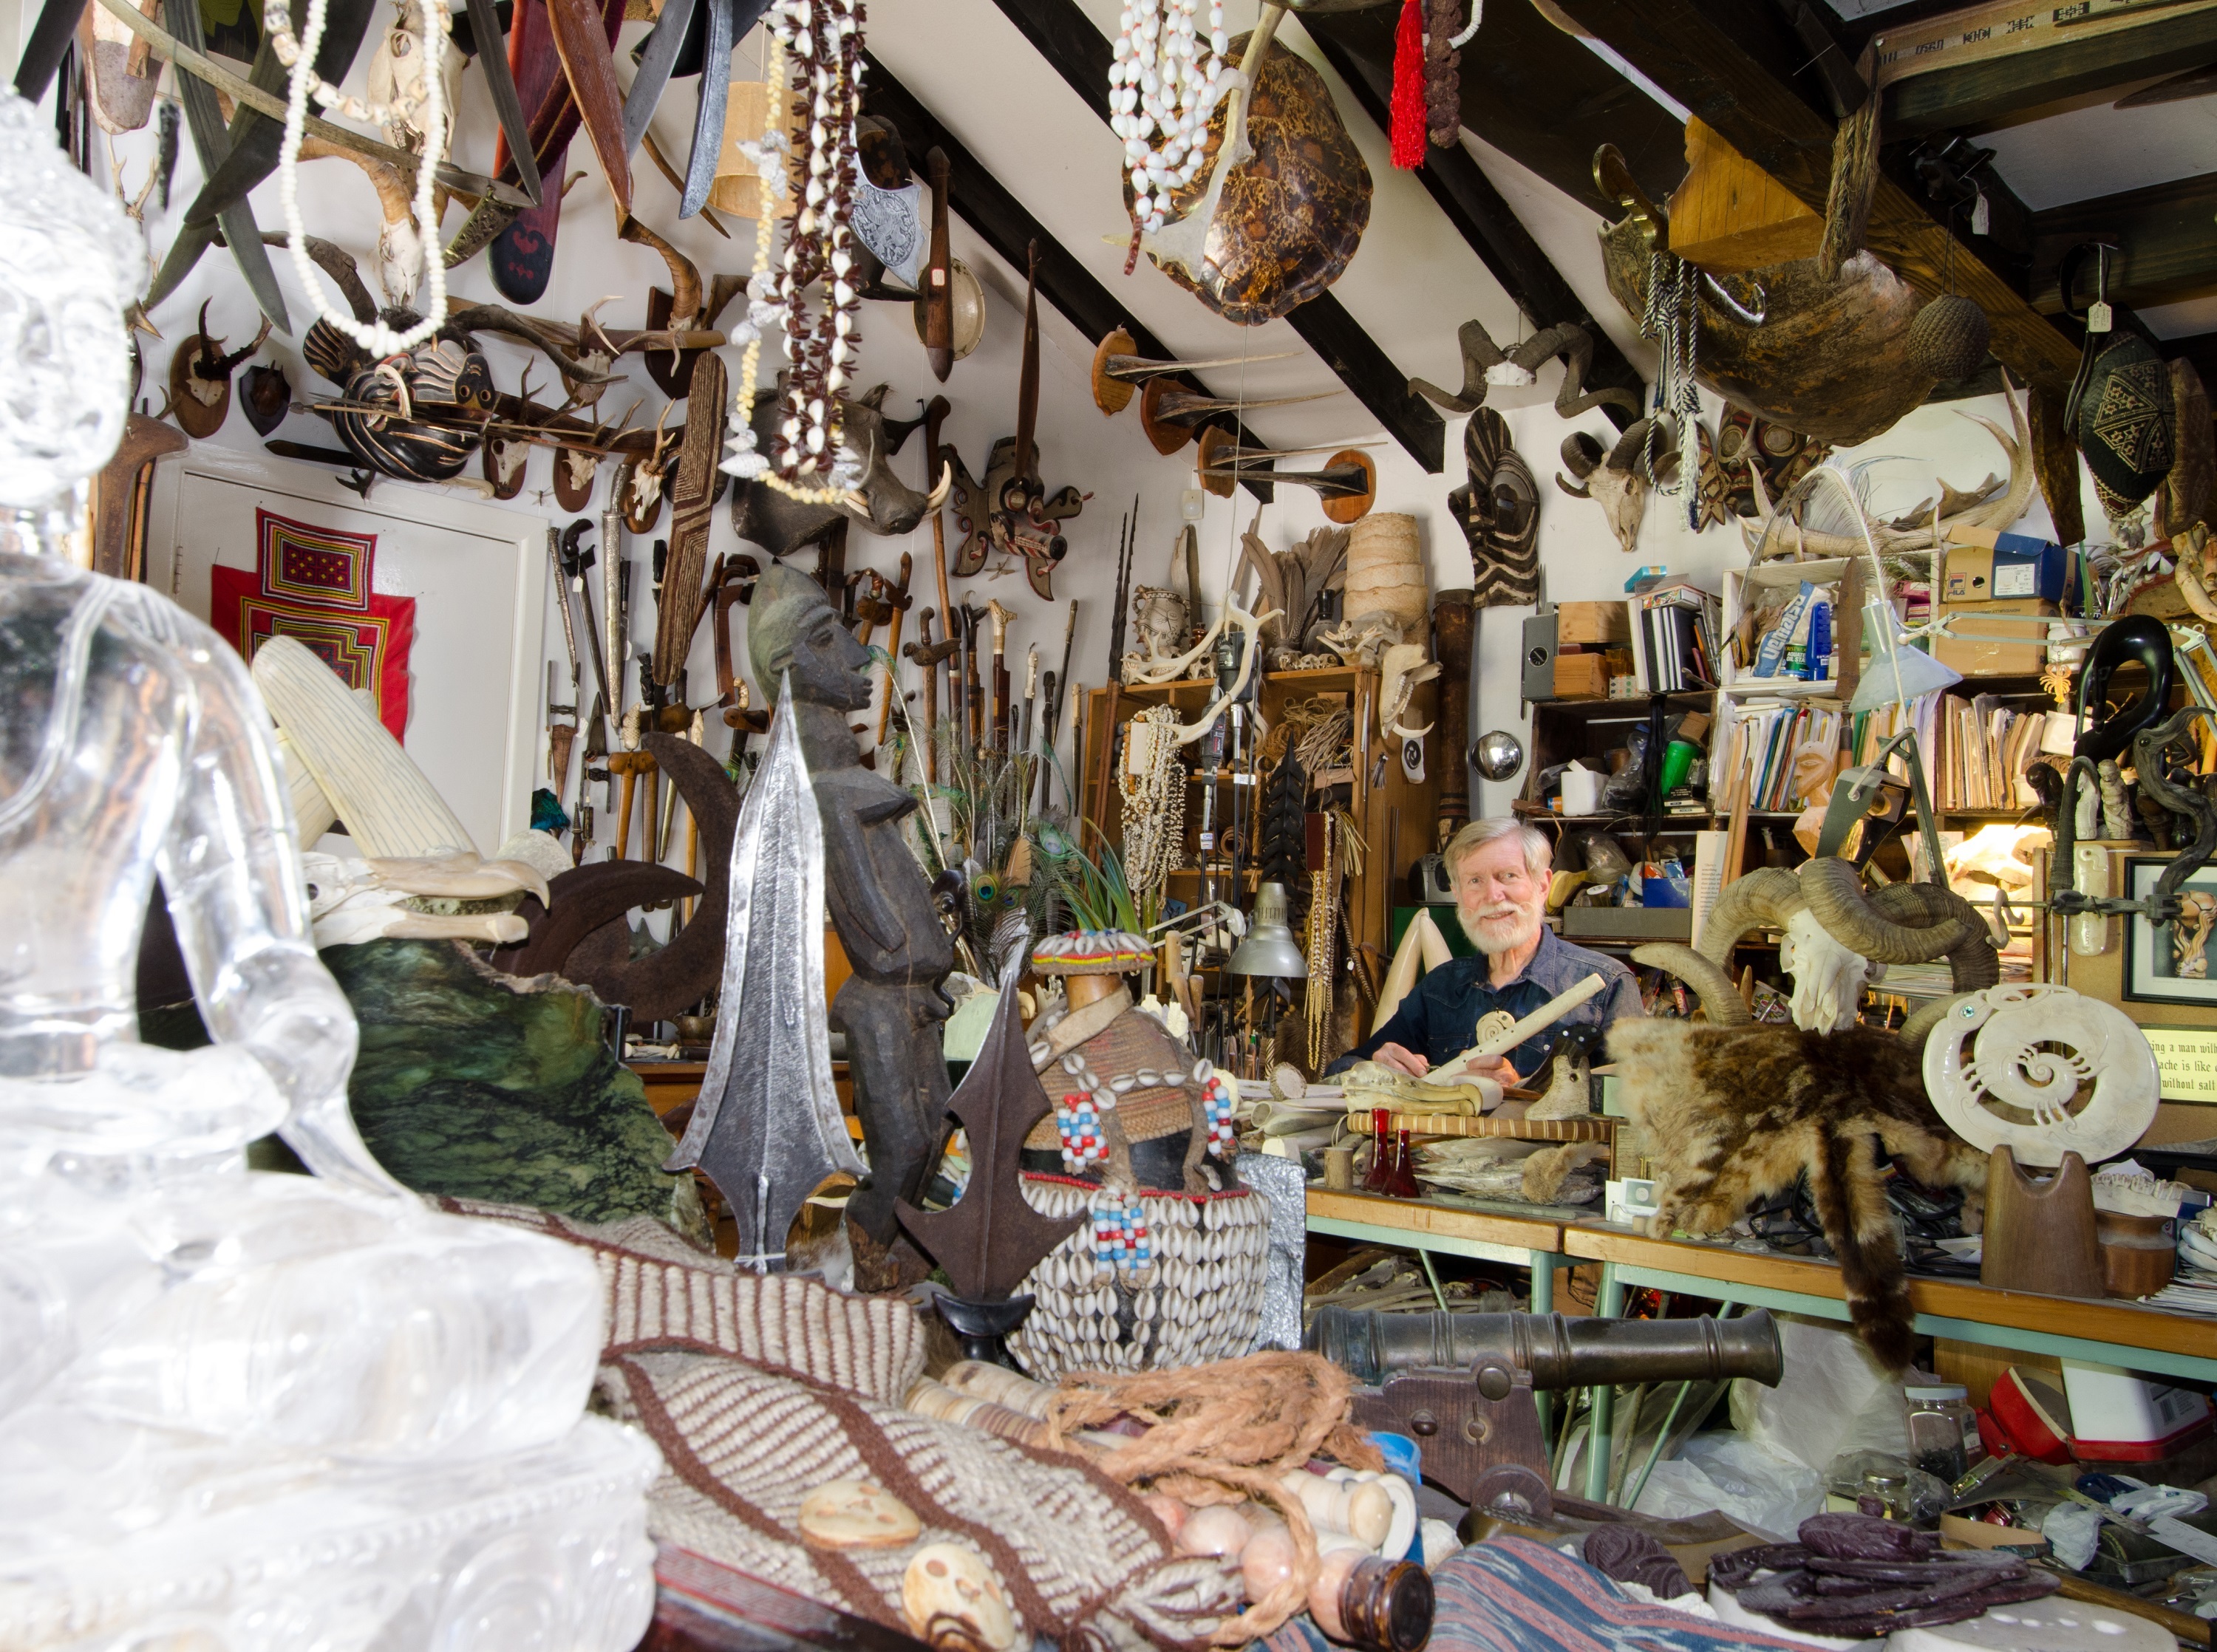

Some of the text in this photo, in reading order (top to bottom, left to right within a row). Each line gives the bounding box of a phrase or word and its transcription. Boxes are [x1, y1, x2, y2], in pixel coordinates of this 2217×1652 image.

[2150, 1040, 2165, 1054] ing
[2170, 1044, 2174, 1052] a
[2179, 1044, 2196, 1053] man
[2182, 1059, 2190, 1071] is
[2195, 1060, 2211, 1072] like
[2162, 1077, 2215, 1090] without salt
